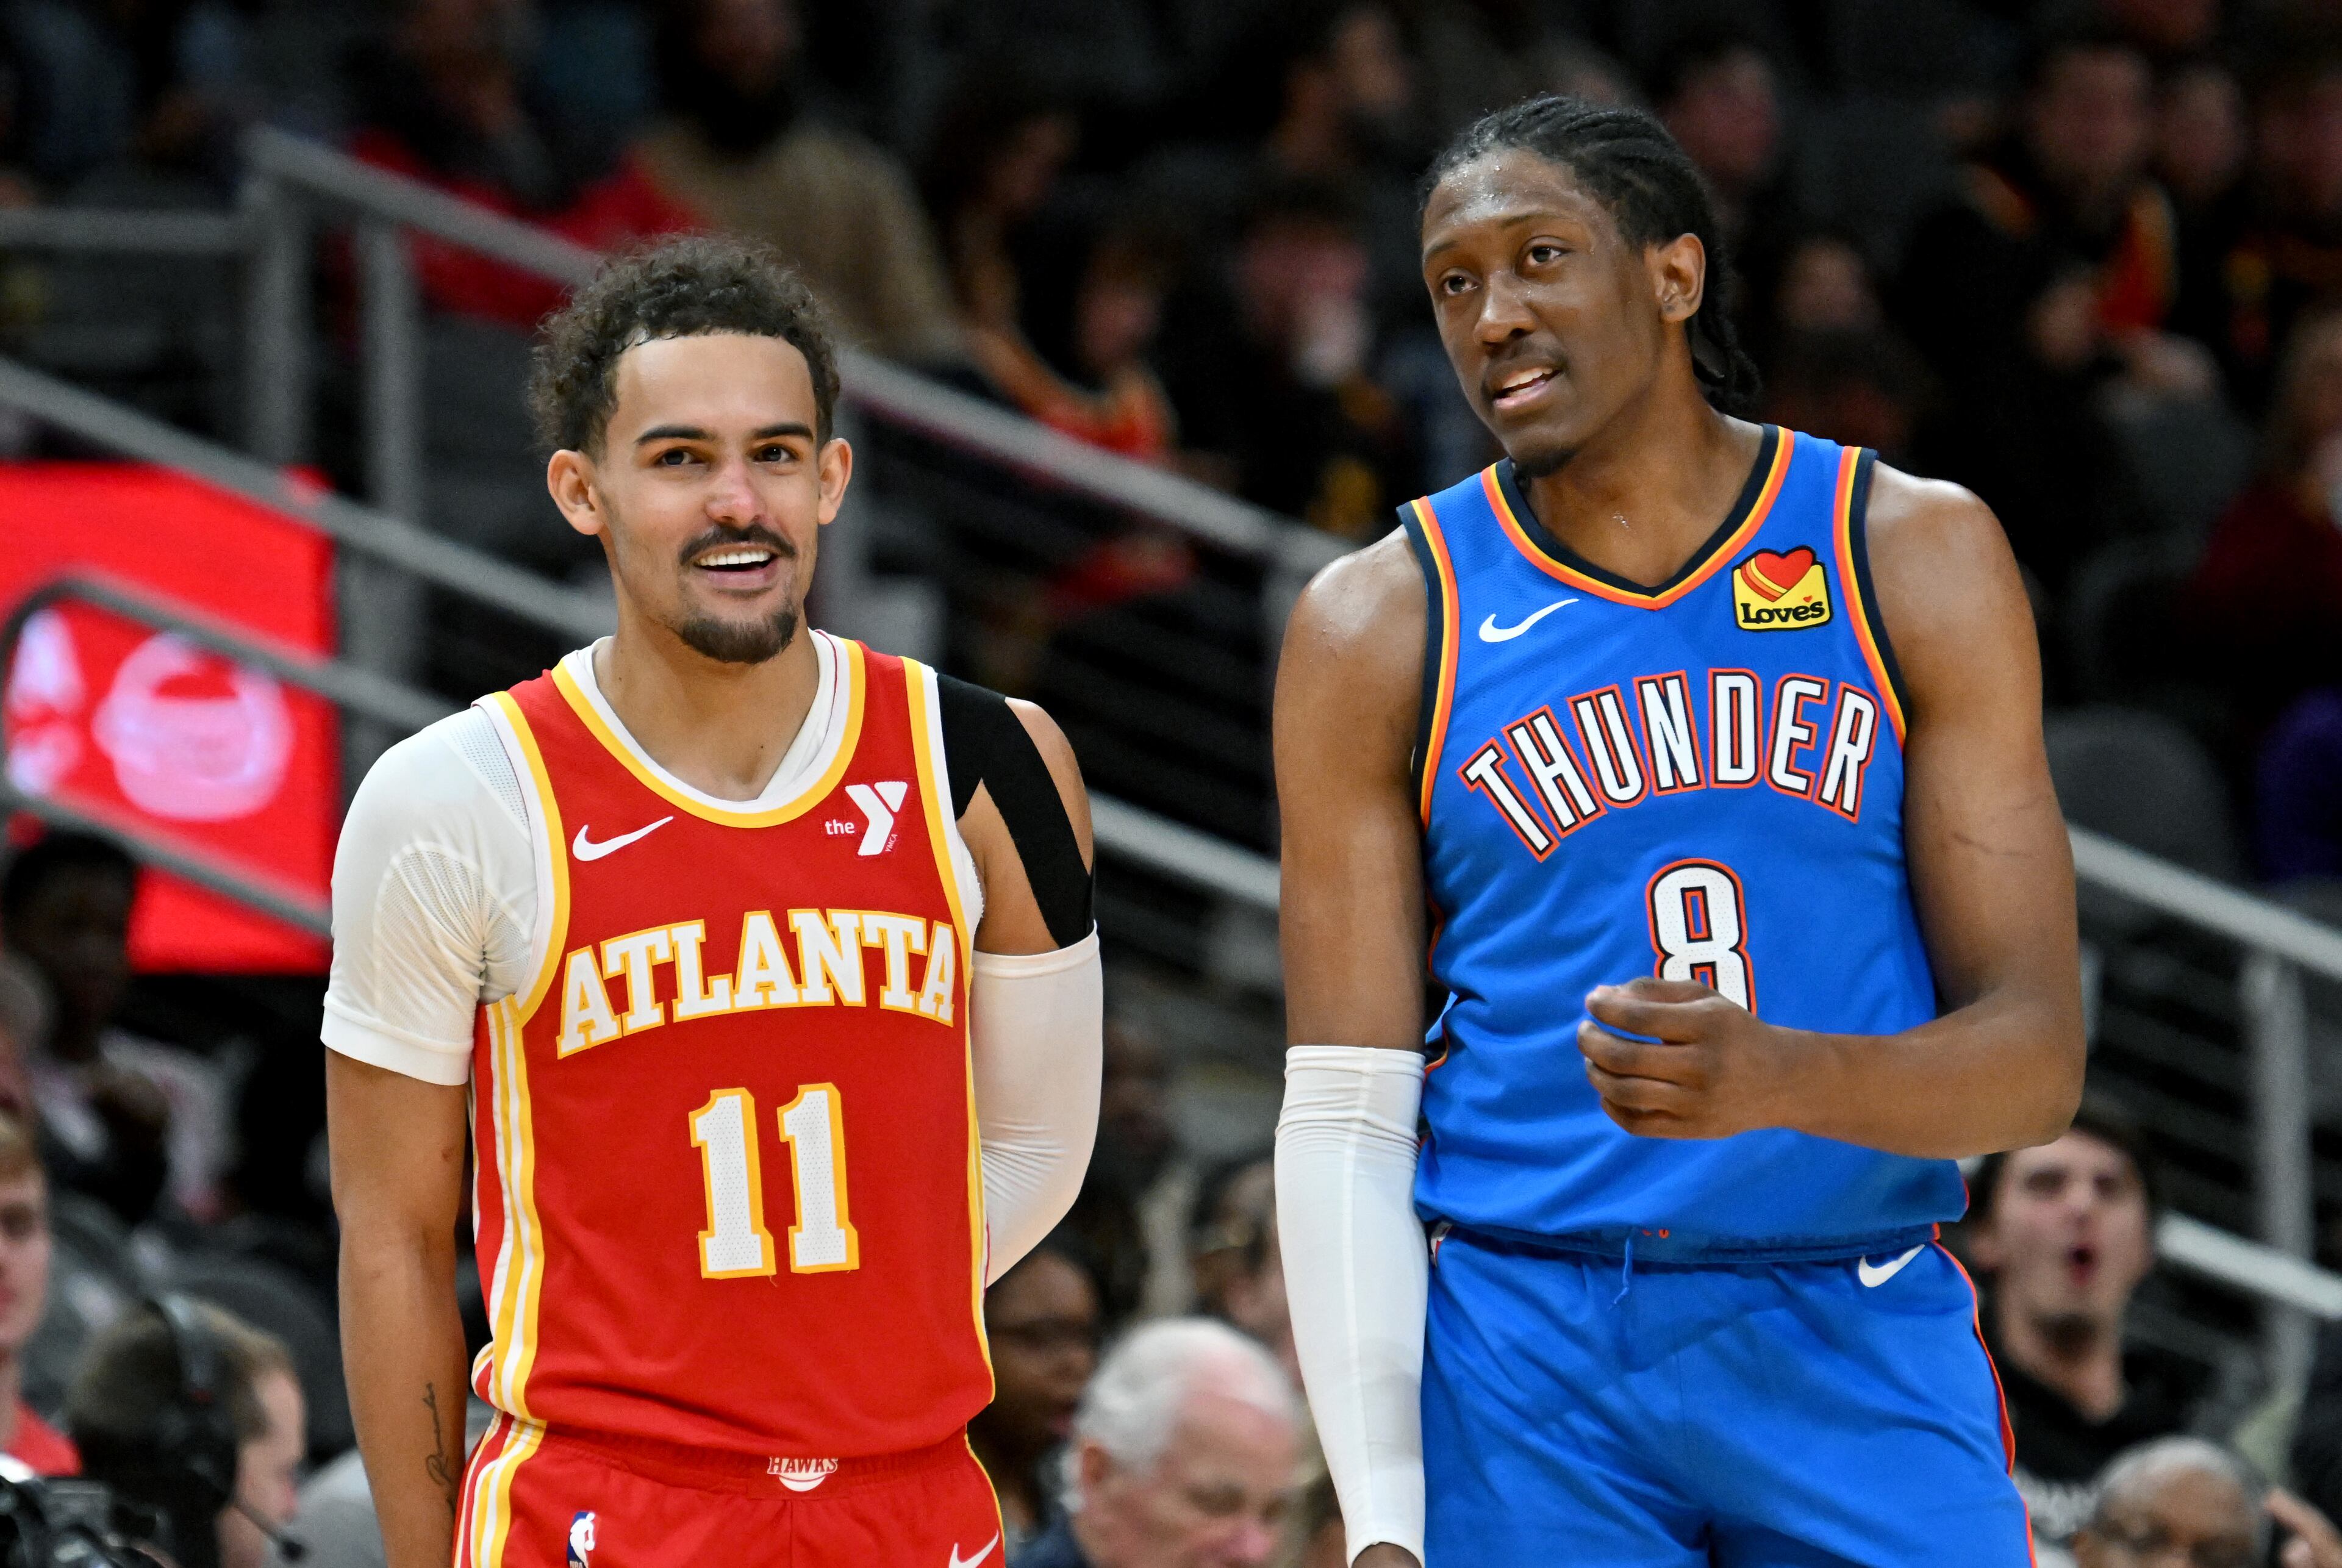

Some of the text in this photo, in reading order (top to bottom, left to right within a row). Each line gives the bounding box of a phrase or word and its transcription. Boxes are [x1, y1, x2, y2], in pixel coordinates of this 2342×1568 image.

[825, 819, 855, 835] the
[1458, 668, 1880, 862] THUNDER
[885, 833, 898, 853] YMCA
[556, 908, 955, 1059] ATLANTA
[1645, 859, 1757, 1014] 8
[689, 1082, 860, 1280] 11
[767, 1456, 839, 1474] HAWKS
